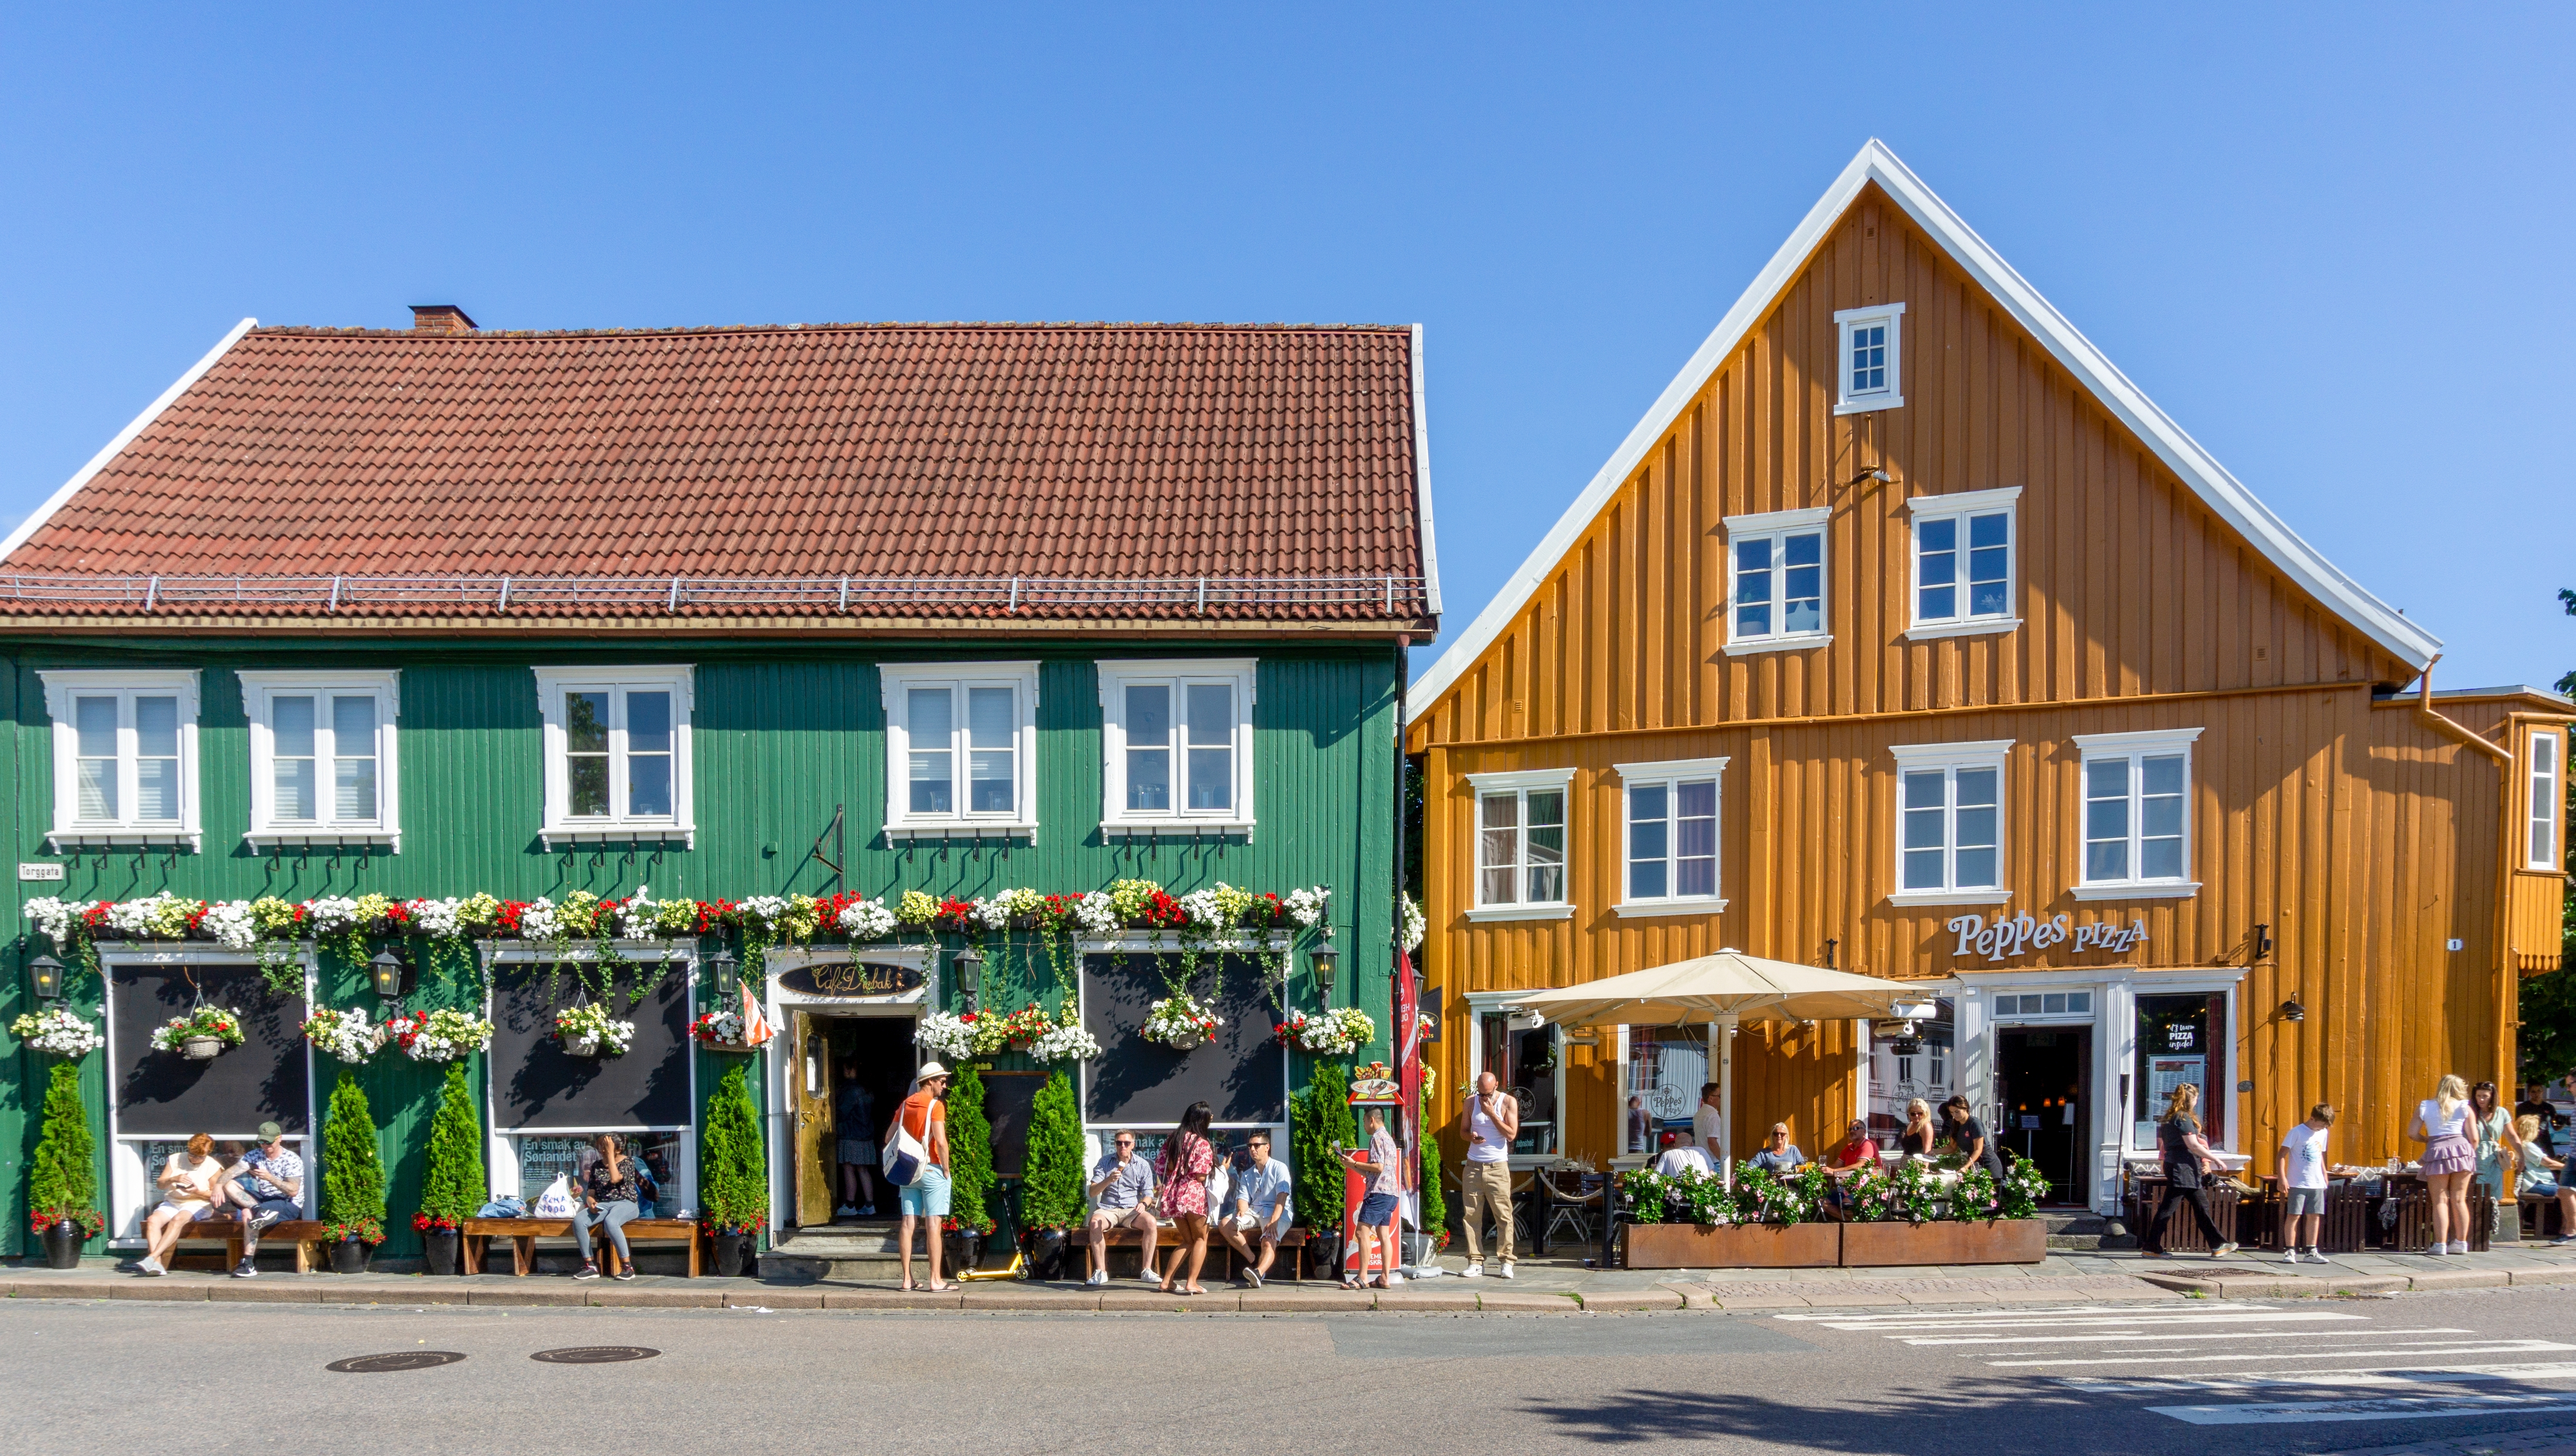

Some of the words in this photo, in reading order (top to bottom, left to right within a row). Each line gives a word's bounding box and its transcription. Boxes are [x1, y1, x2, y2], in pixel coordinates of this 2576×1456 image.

[22, 866, 59, 878] Torggata
[1947, 910, 2067, 962] Peppes
[2072, 919, 2149, 953] PIZZA
[2452, 940, 2457, 949] 1
[2169, 1032, 2193, 1040] PIZZA
[2169, 1039, 2193, 1050] inside!
[1517, 1098, 1532, 1110] pes
[1653, 1096, 1682, 1107] Peppes
[525, 1140, 538, 1150] En
[541, 1139, 571, 1150] smak
[574, 1141, 586, 1150] av
[1135, 1136, 1155, 1147] mak
[152, 1145, 165, 1154] En
[168, 1146, 188, 1154] sma
[525, 1151, 577, 1162] Sørlandet
[543, 1204, 565, 1213] 1000
